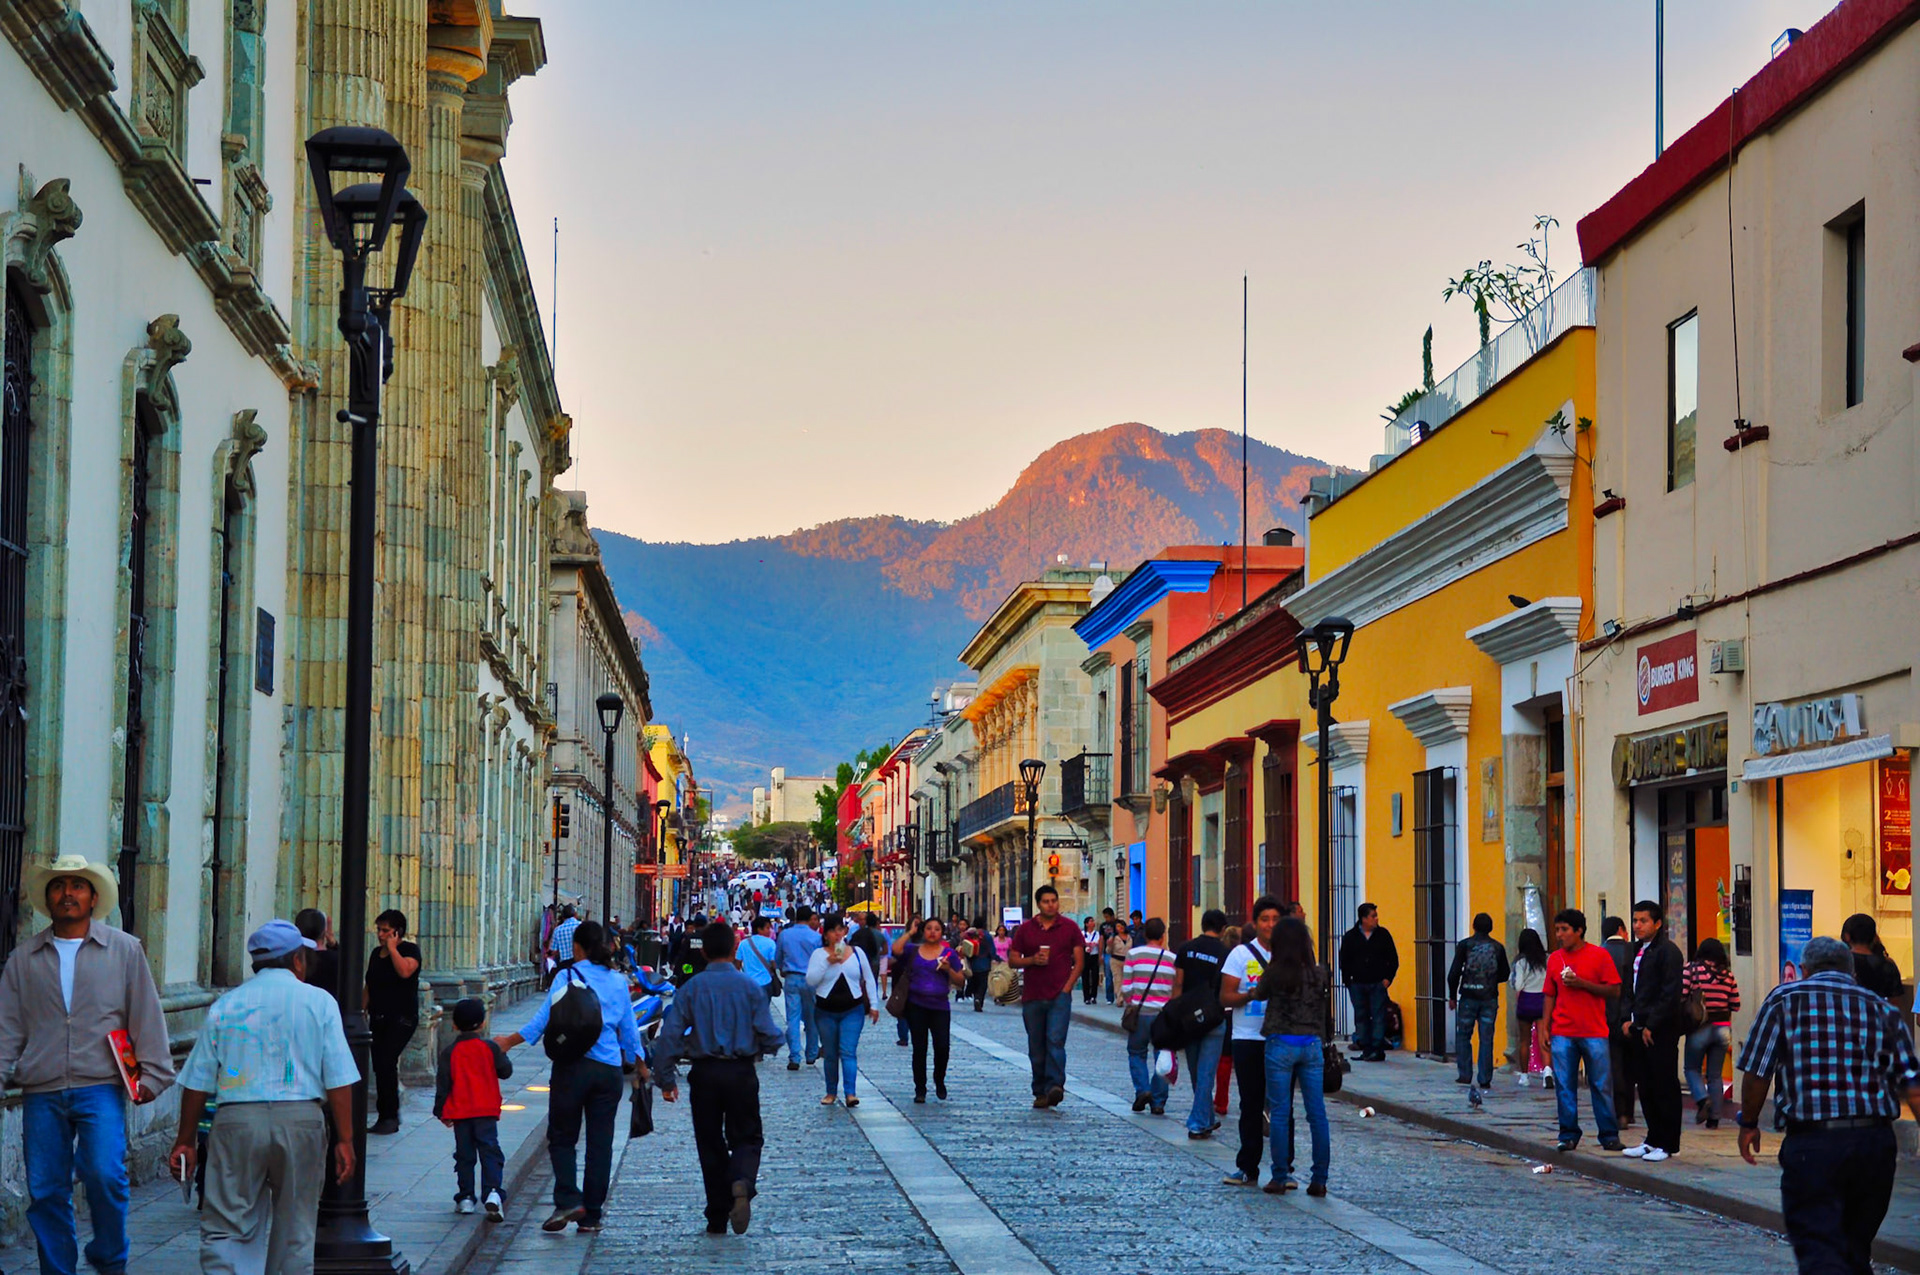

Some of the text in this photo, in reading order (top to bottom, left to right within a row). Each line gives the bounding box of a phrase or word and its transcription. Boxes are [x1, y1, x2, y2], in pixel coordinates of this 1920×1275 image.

[1650, 661, 1676, 689] BURGER
[1677, 655, 1695, 681] KING
[1626, 734, 1678, 781] BURGER
[1884, 810, 1892, 820] 2
[1884, 841, 1892, 852] 3
